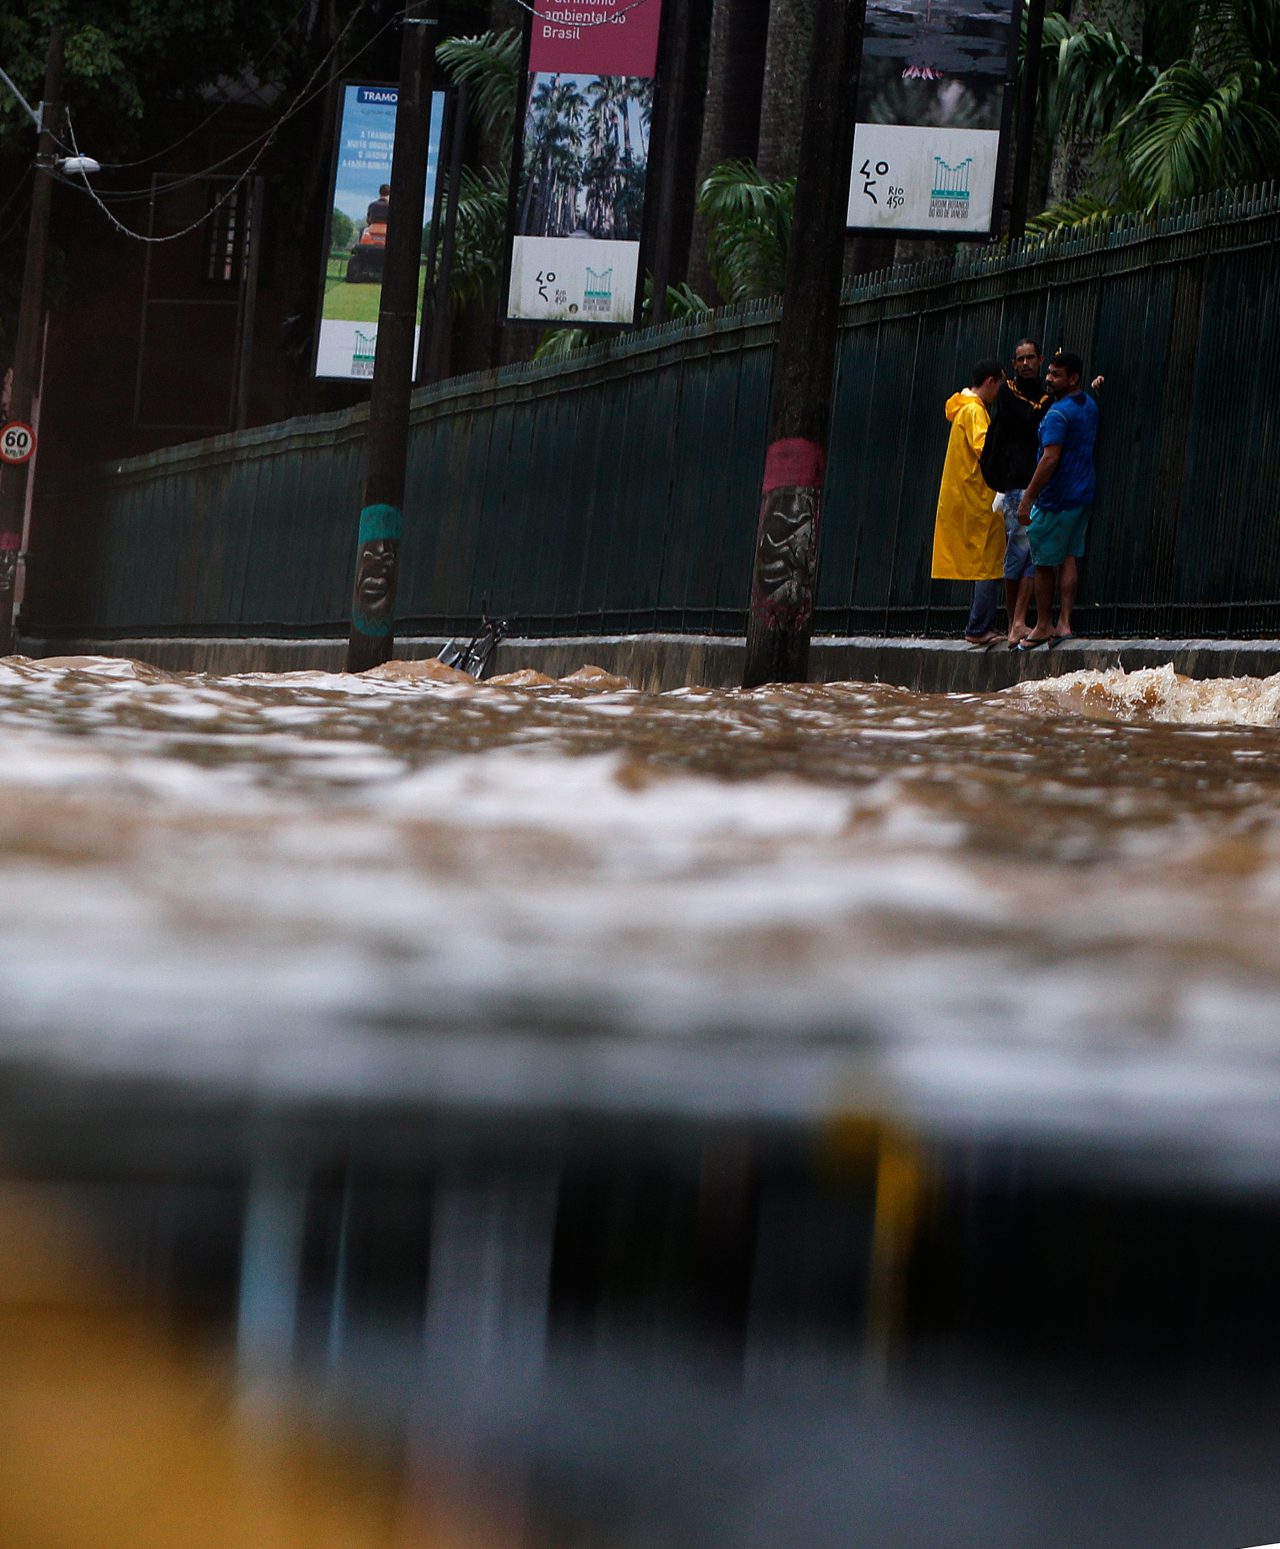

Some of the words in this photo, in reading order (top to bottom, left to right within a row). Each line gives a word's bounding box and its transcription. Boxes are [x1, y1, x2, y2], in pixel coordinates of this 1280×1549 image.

[545, 9, 607, 23] ambiental
[543, 25, 580, 39] Brasil
[363, 91, 398, 102] TRAMO
[888, 186, 904, 195] RIO
[886, 196, 904, 208] 450
[6, 431, 28, 447] 60
